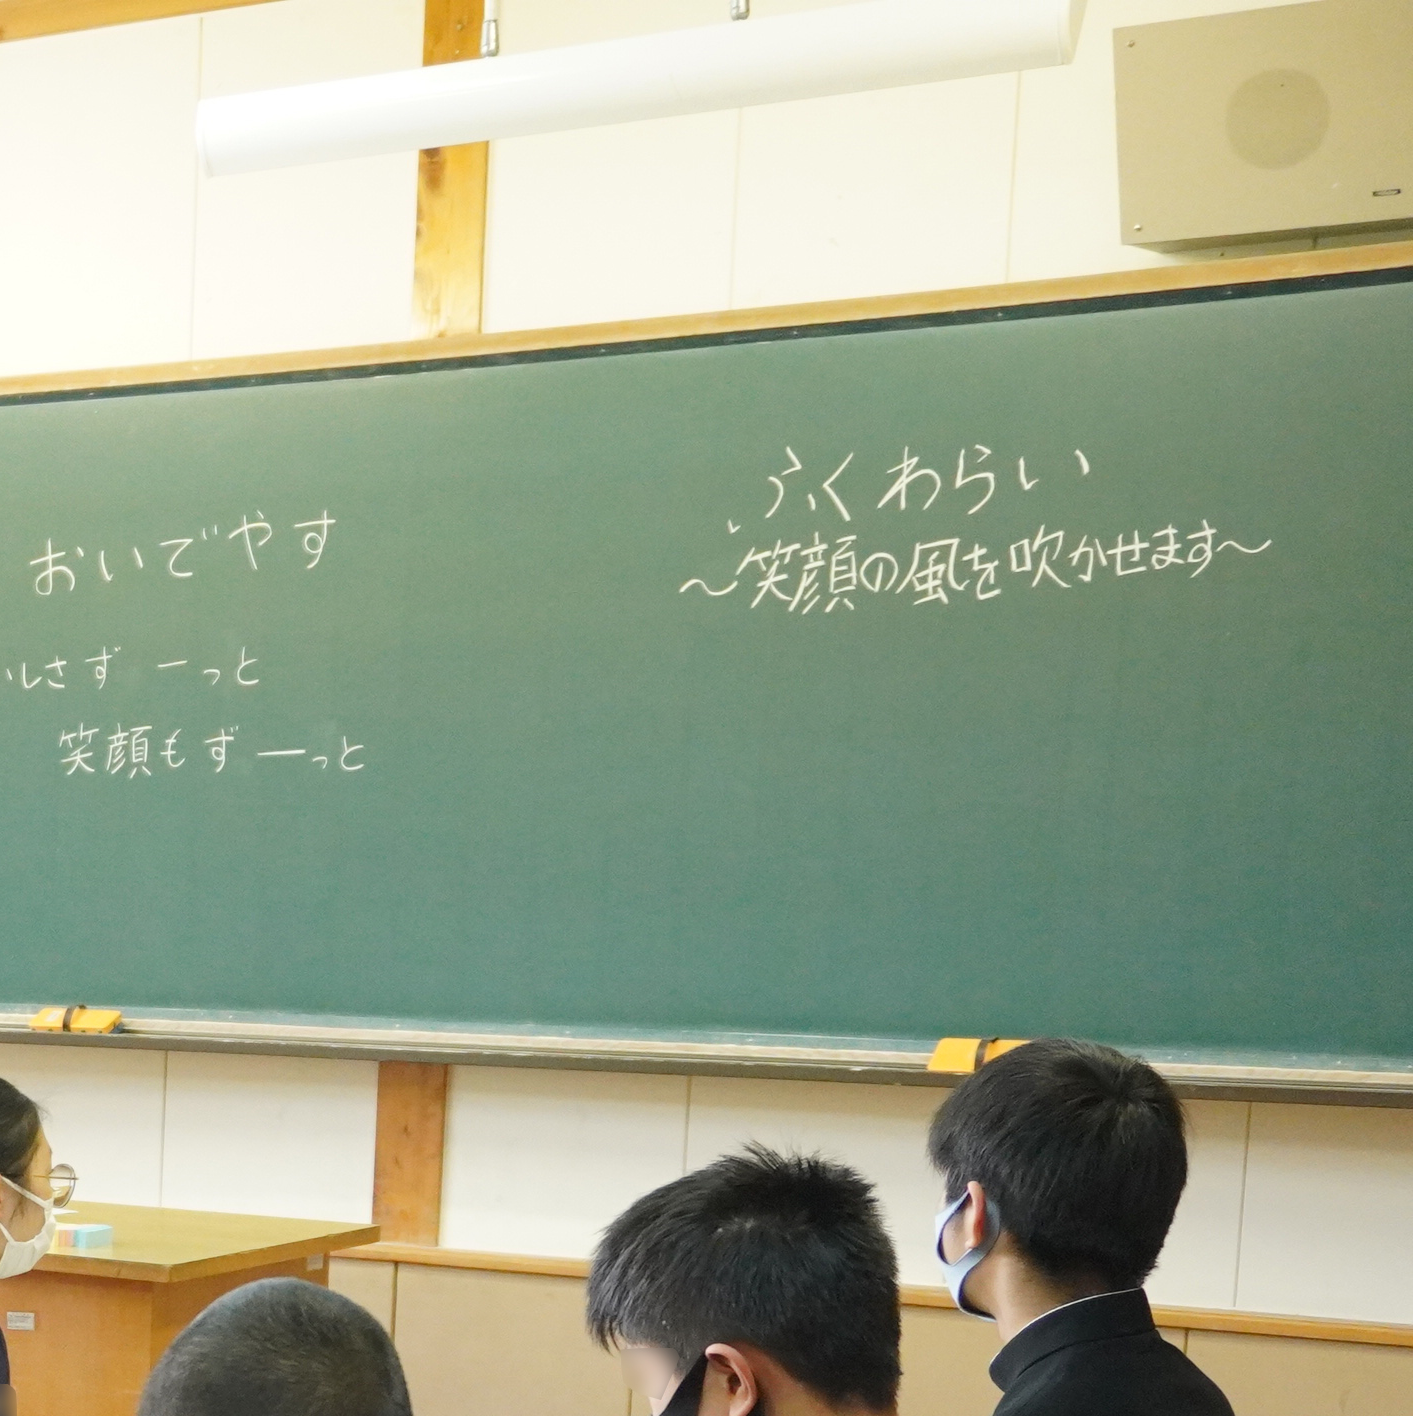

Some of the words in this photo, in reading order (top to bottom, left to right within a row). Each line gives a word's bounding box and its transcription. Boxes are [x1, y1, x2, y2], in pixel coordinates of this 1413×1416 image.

[727, 442, 1092, 535] ふくわらい
[28, 508, 337, 597] おいでやす
